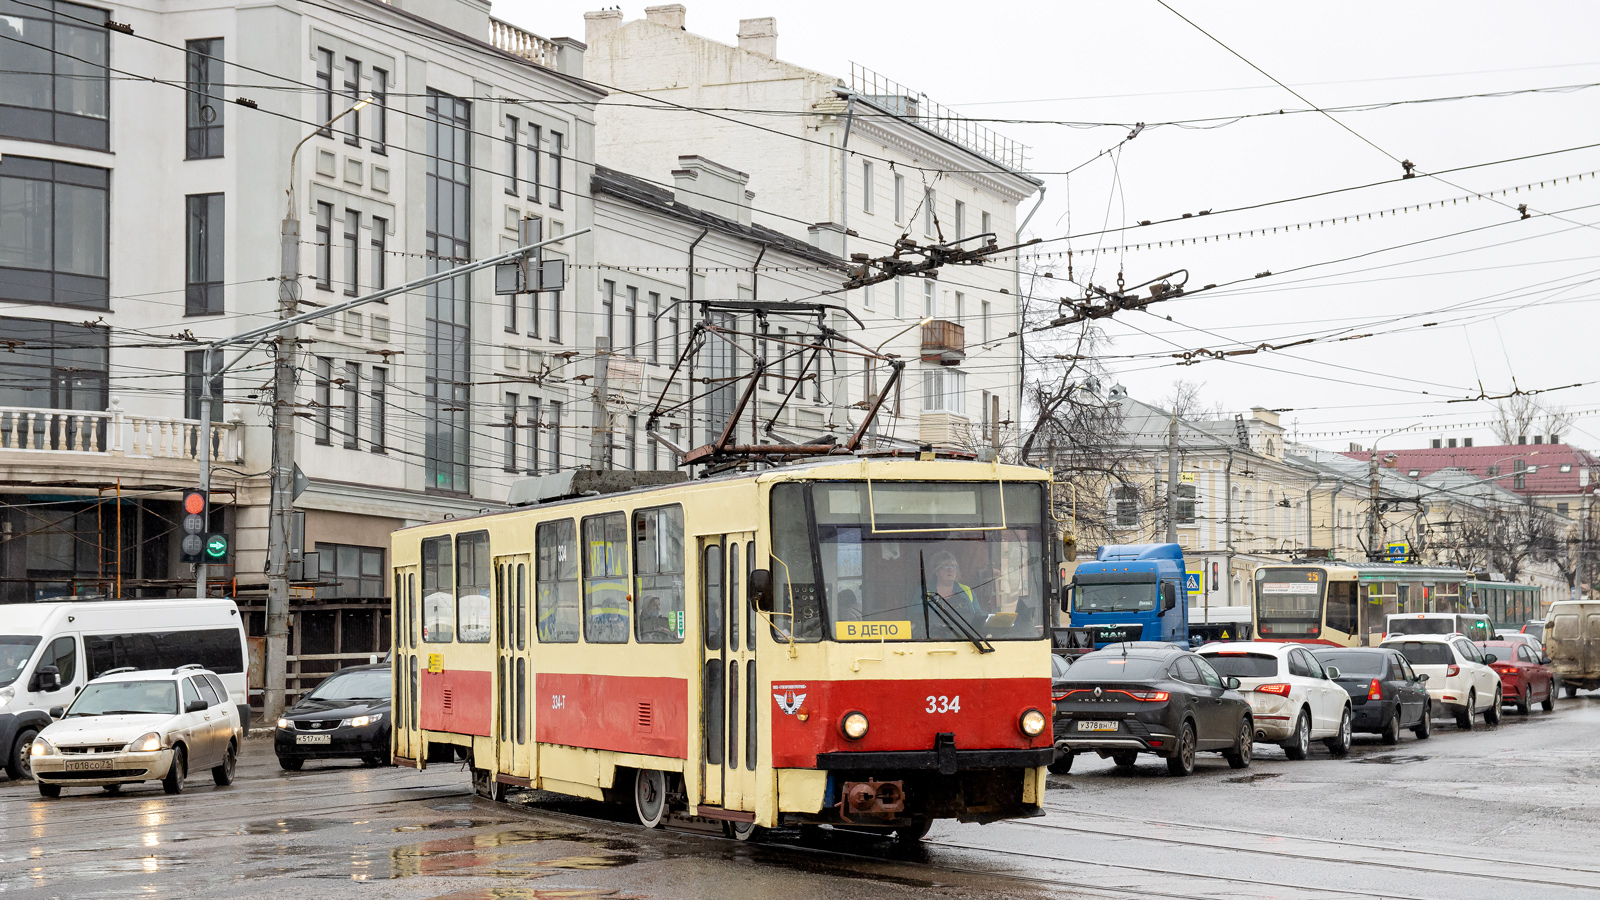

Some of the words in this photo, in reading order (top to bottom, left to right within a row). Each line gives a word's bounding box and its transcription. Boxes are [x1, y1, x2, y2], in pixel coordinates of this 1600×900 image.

[558, 545, 567, 561] 334
[1307, 571, 1319, 581] 15
[847, 624, 857, 636] В
[861, 624, 898, 637] ДЕПО
[925, 695, 961, 714] 334
